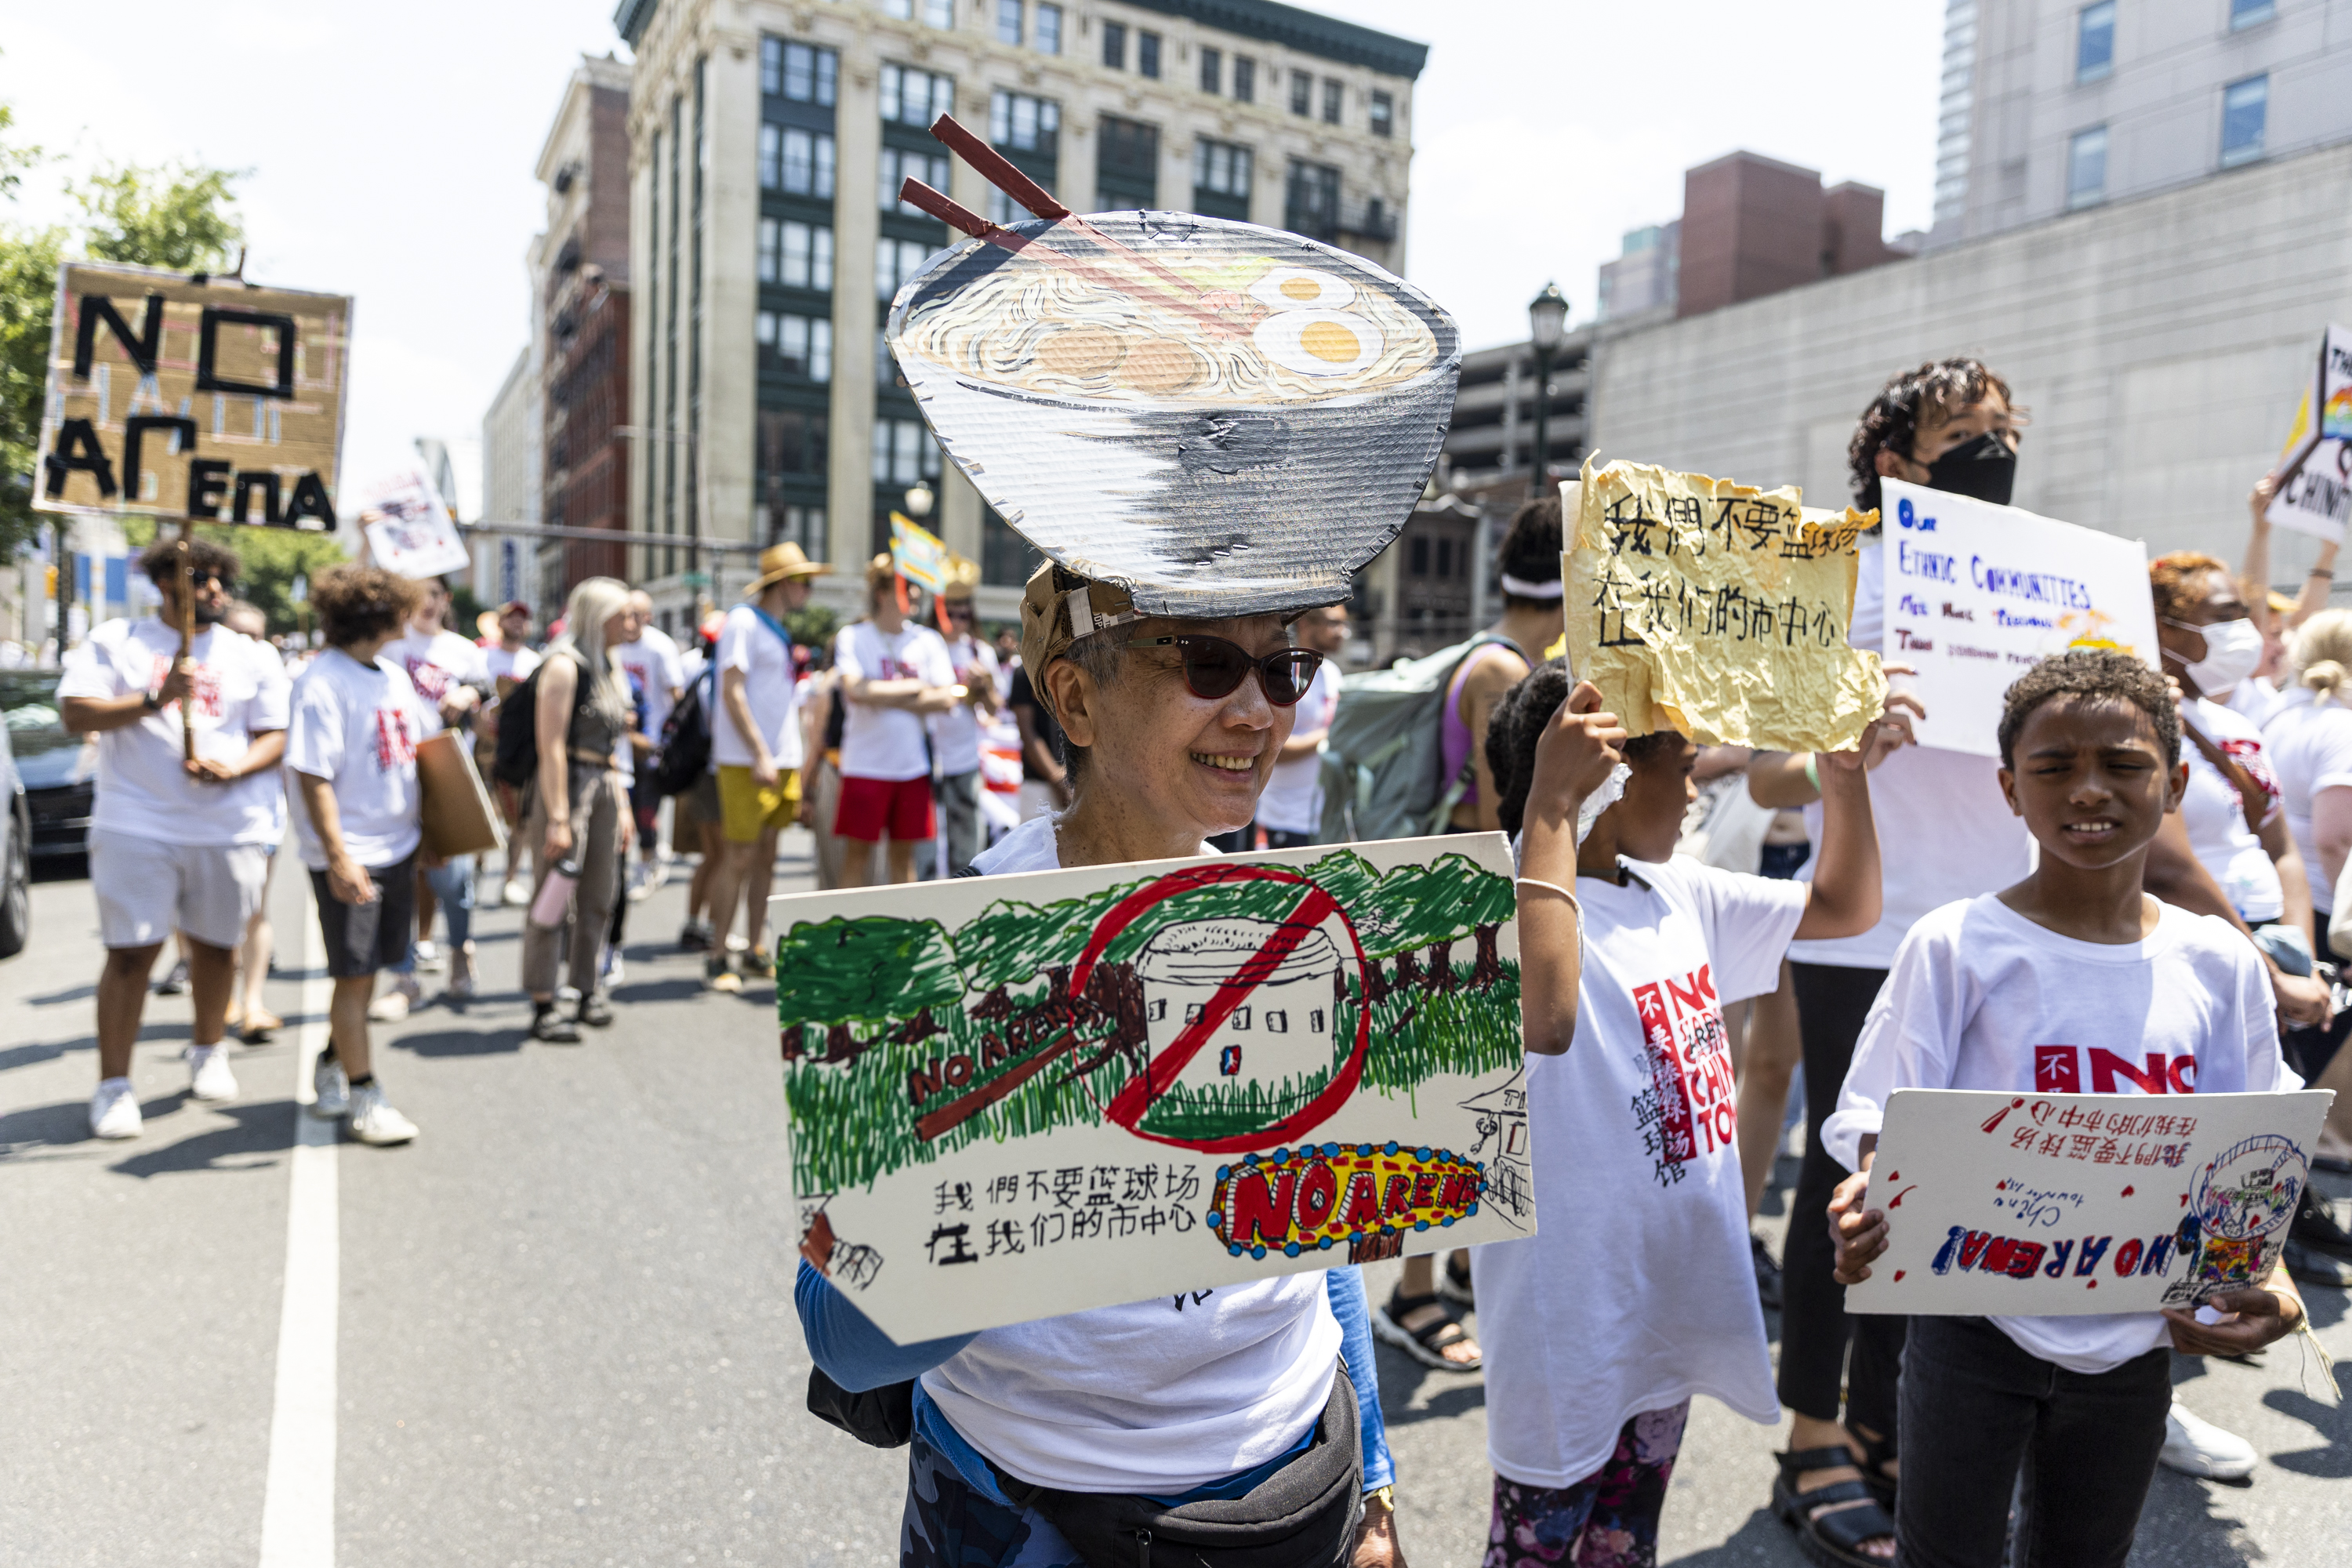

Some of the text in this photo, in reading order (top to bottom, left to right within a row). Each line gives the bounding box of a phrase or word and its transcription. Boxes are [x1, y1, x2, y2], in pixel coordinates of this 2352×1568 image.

[74, 293, 296, 397] NO
[909, 1055, 975, 1106] NO
[1225, 1159, 1479, 1243] NO ARENA
[924, 1203, 1197, 1266] 在我们的市中心
[1931, 1225, 2178, 1279] NO ARENA!
